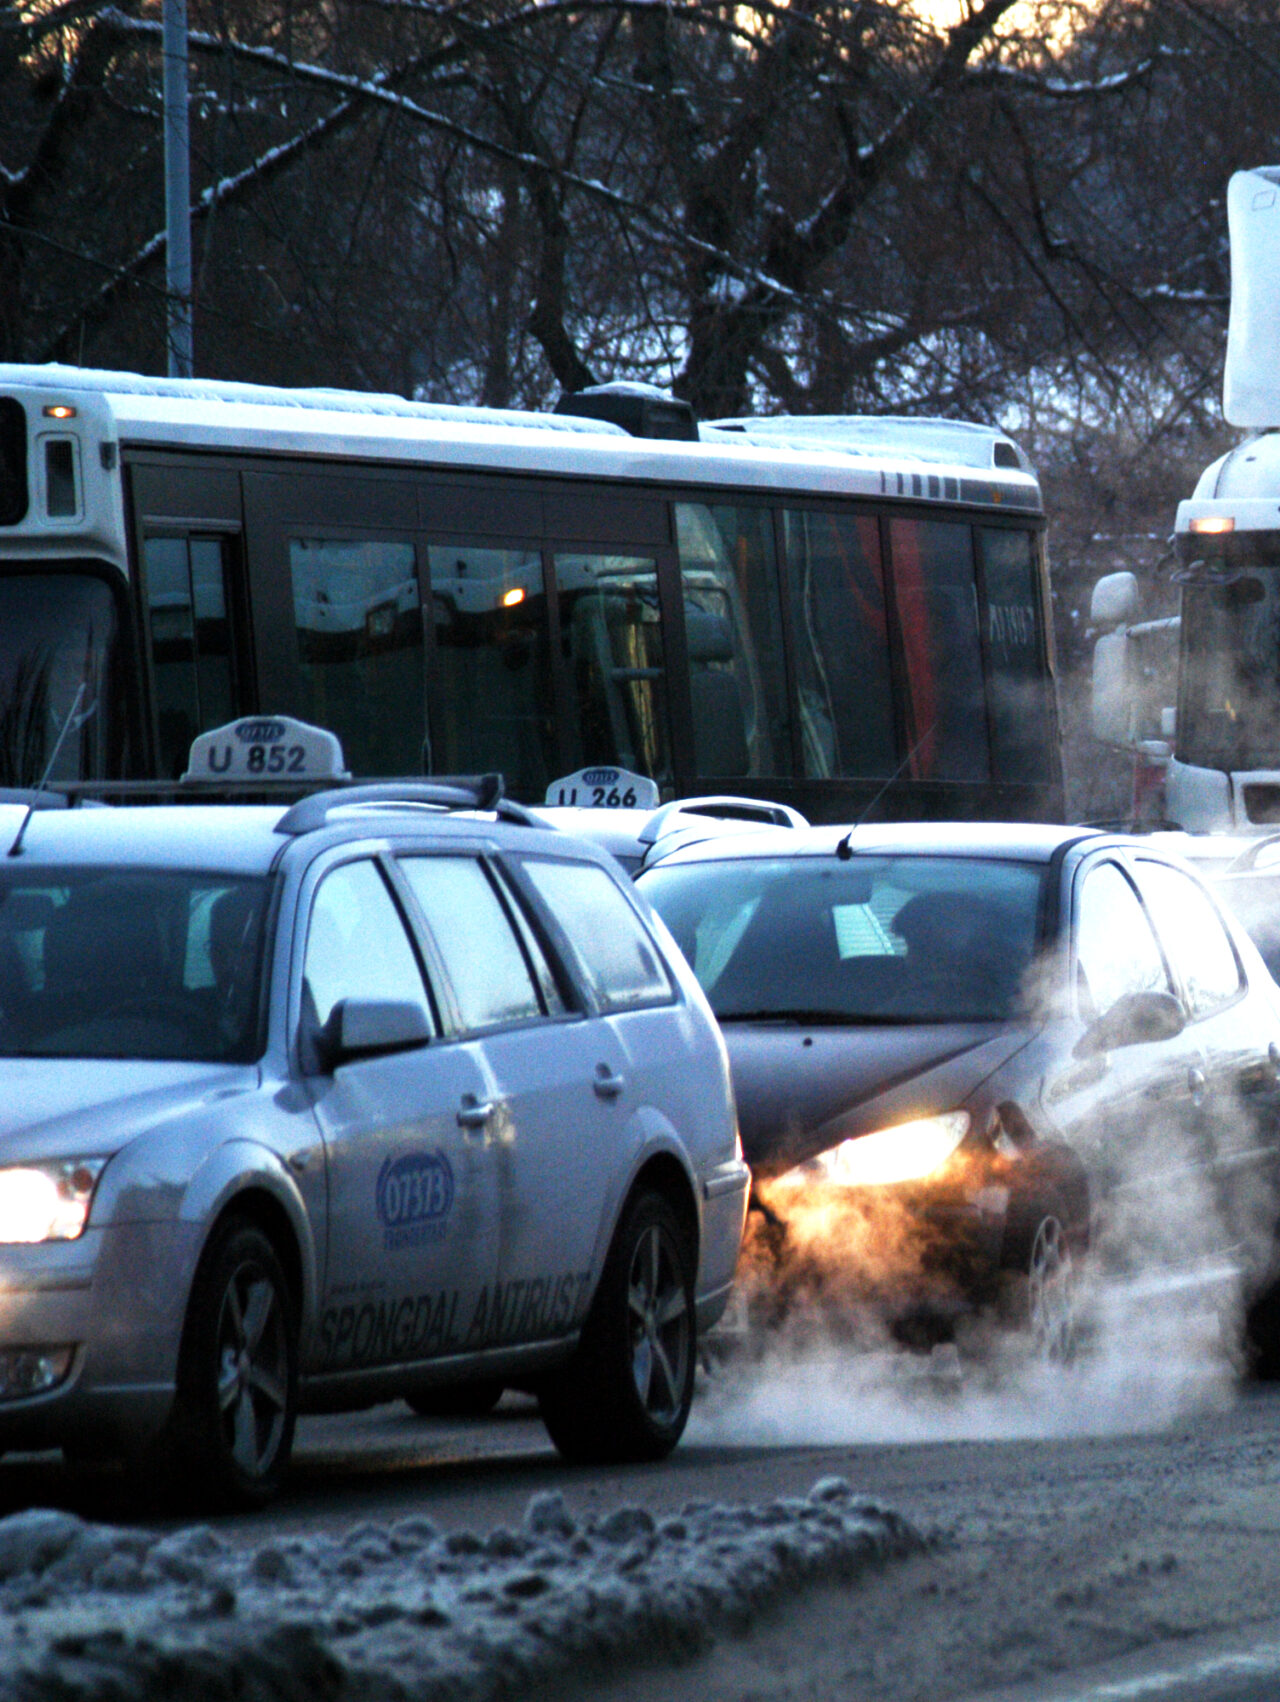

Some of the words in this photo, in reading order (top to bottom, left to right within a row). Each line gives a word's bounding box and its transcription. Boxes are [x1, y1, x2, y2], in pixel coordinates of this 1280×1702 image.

[208, 745, 232, 773] U
[247, 745, 306, 773] 852
[558, 788, 578, 806] U
[592, 787, 637, 807] 266
[384, 1167, 446, 1222] 07373
